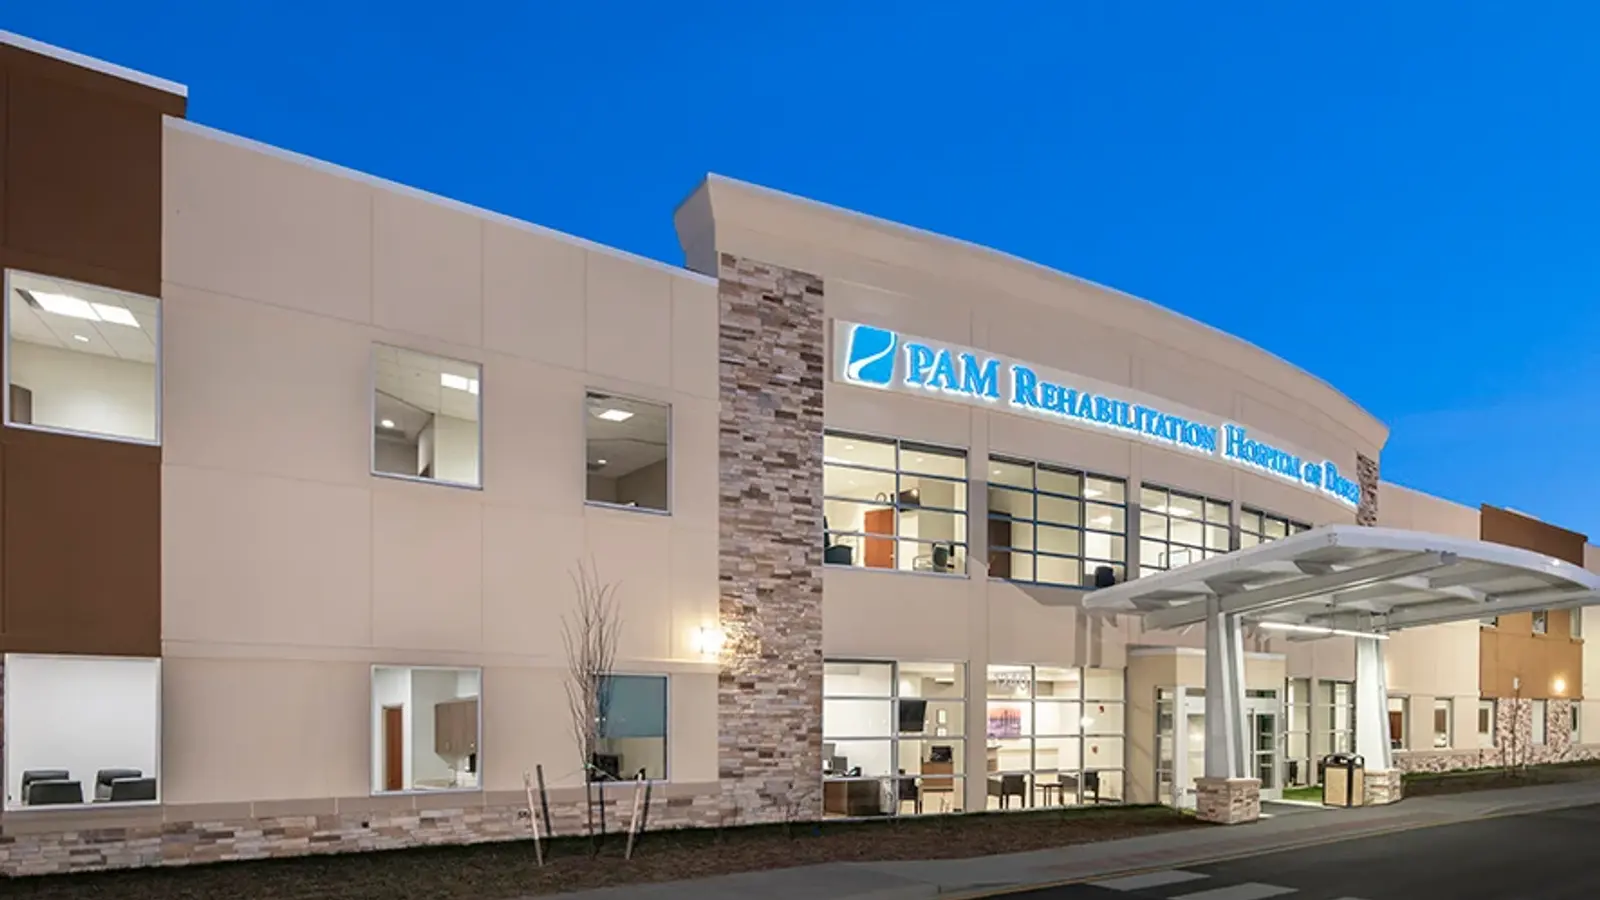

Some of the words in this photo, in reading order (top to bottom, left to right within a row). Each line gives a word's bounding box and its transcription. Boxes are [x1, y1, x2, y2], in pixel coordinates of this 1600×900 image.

[904, 343, 1001, 398] PAM
[1011, 366, 1217, 452] REHABILITATION
[1224, 424, 1302, 479] HOSPITAL
